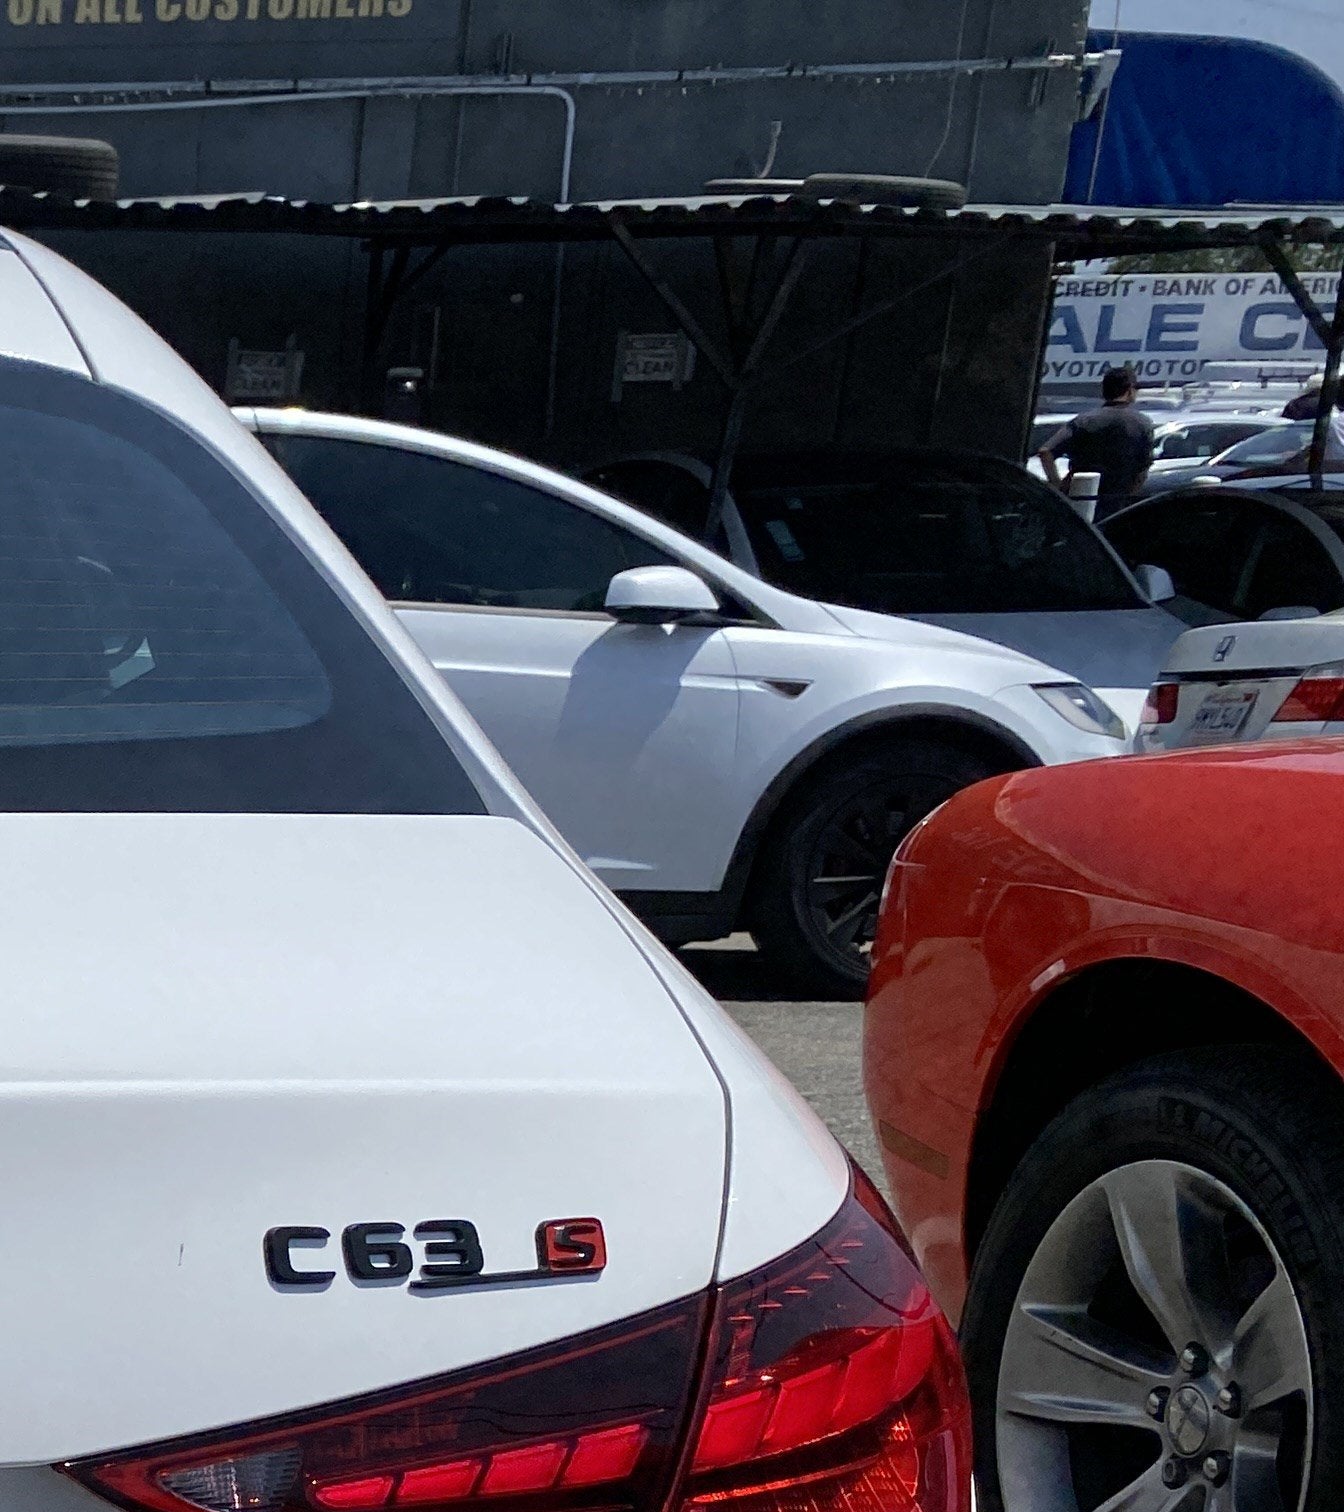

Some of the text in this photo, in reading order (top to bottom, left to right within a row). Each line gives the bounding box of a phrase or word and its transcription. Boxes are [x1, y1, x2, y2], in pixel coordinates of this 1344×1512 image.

[1152, 279, 1217, 296] BANK
[1224, 278, 1255, 295] OF
[549, 1220, 601, 1269] S
